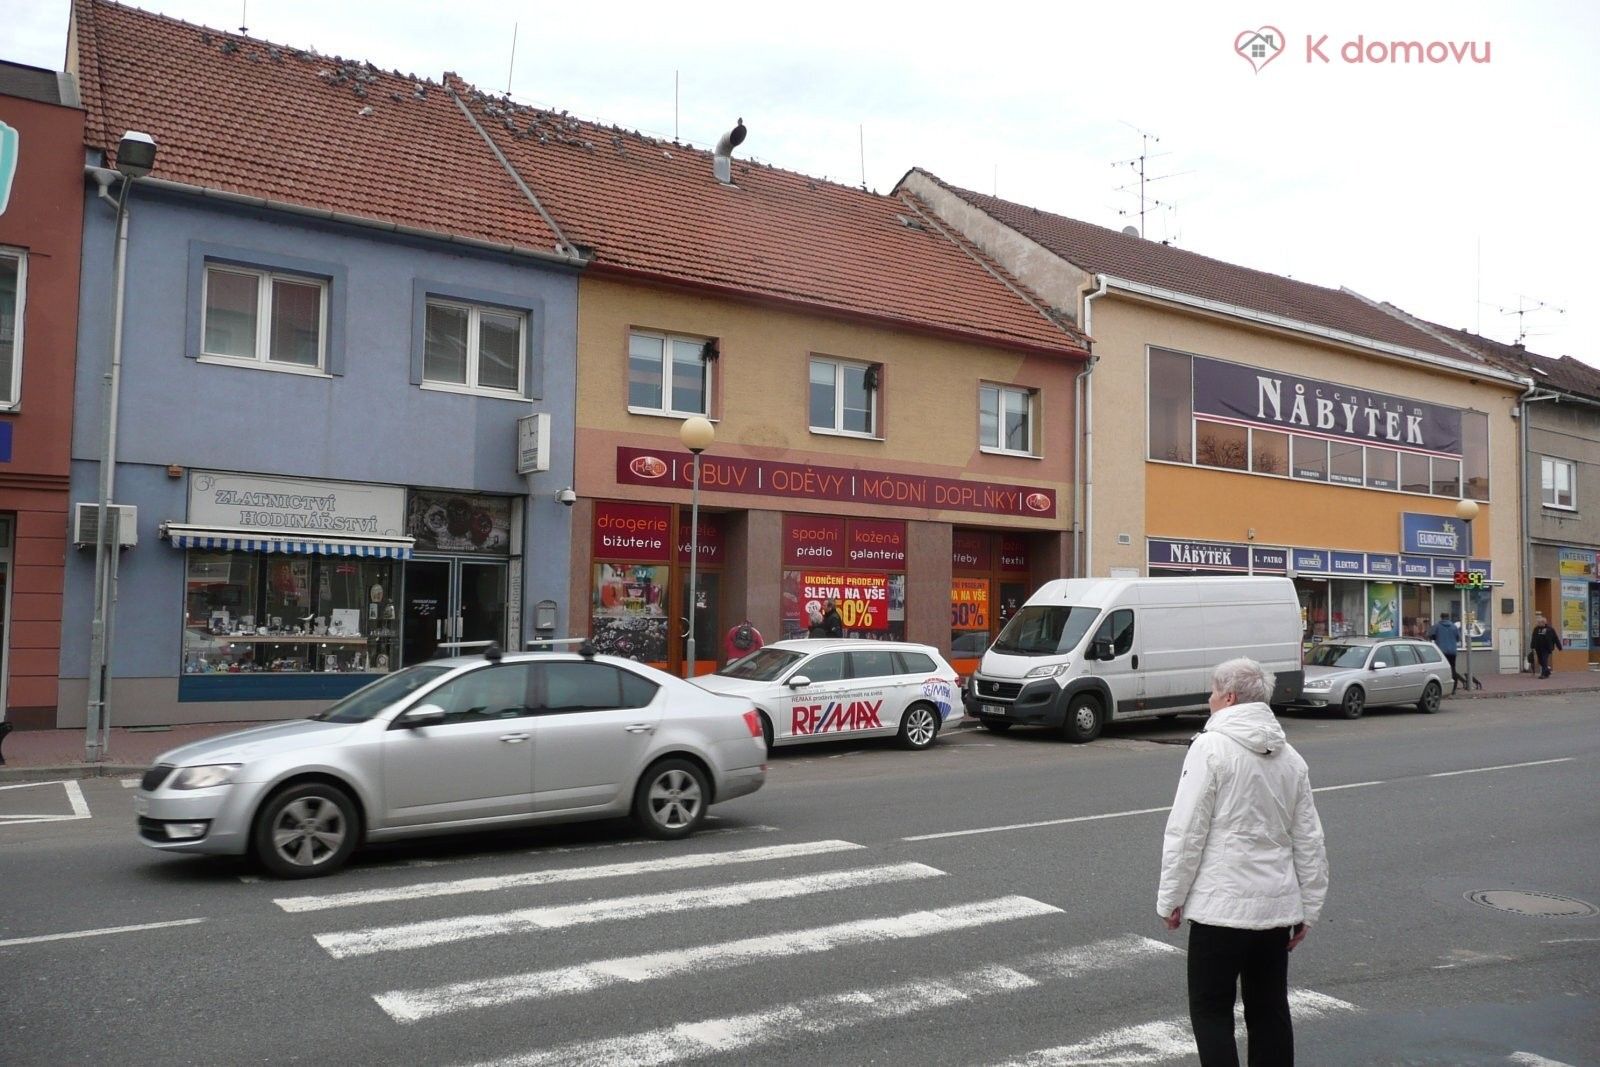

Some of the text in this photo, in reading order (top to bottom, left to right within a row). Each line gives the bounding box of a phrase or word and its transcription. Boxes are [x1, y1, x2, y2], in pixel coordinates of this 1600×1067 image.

[1316, 389, 1423, 415] centrum
[683, 462, 747, 486] OBUV
[772, 469, 843, 494] ODĚVY
[863, 477, 926, 502] MÓDNÍ
[215, 490, 335, 511] ZLATNICTVÍ
[240, 510, 377, 532] HODINÁŘSTVÍ
[598, 514, 667, 532] drogerie
[603, 535, 661, 549] bižuterie
[855, 530, 900, 544] kožená
[1420, 533, 1453, 546] EURONICS
[796, 546, 832, 557] prádlo
[850, 550, 904, 562] galanterie
[1562, 552, 1592, 561] INTERNET
[1002, 556, 1024, 565] textil
[1264, 556, 1283, 564] PATRO
[1335, 561, 1358, 569] ELEKTRO
[1406, 564, 1426, 573] ELEKTRO
[805, 575, 885, 586] UKONČENÍ PRODEJNY
[804, 586, 885, 600] SLEVA NA VŠE
[792, 695, 812, 703] RE/MAX
[792, 699, 883, 736] RE/MAX
